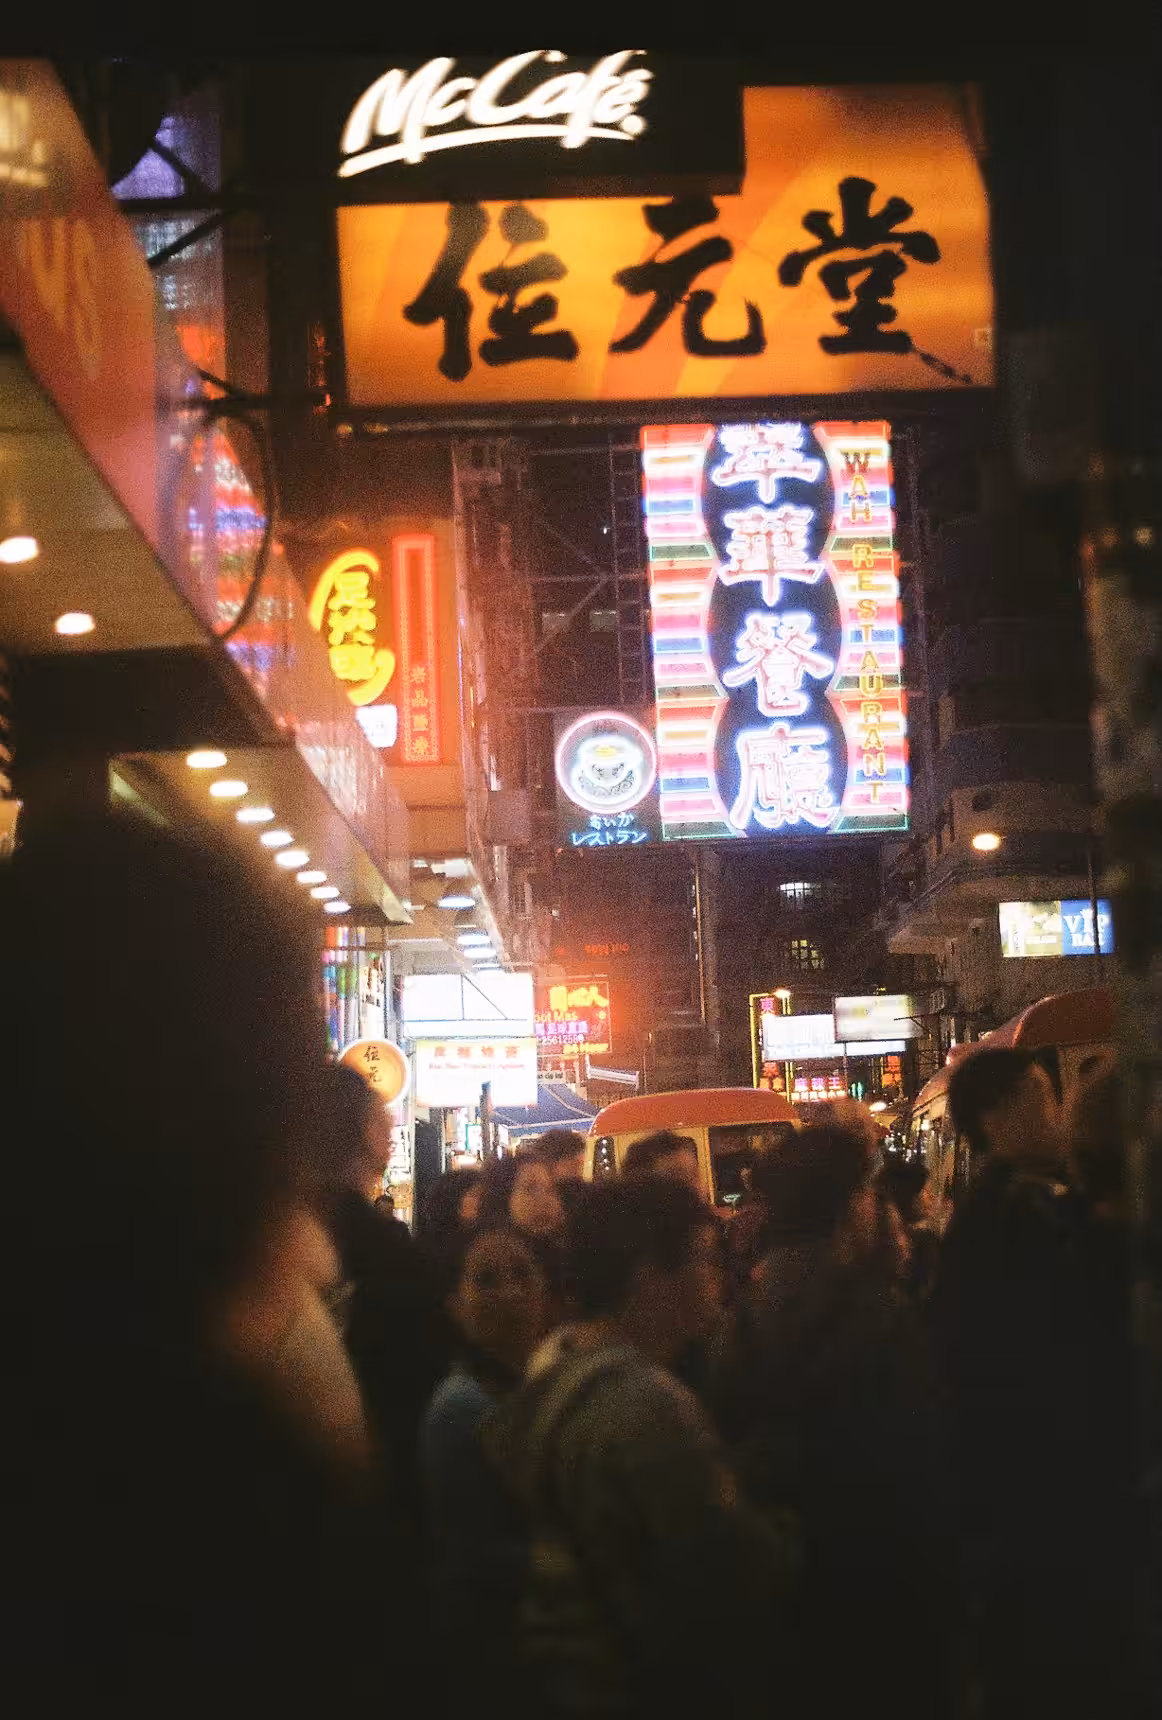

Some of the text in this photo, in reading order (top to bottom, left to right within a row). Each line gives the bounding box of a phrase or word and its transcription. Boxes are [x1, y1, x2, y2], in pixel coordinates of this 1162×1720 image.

[403, 177, 942, 382] 位元堂
[711, 421, 841, 830] 翠華餐廳
[840, 451, 886, 804] WAH RESTAURANT
[571, 829, 648, 846] レストラン
